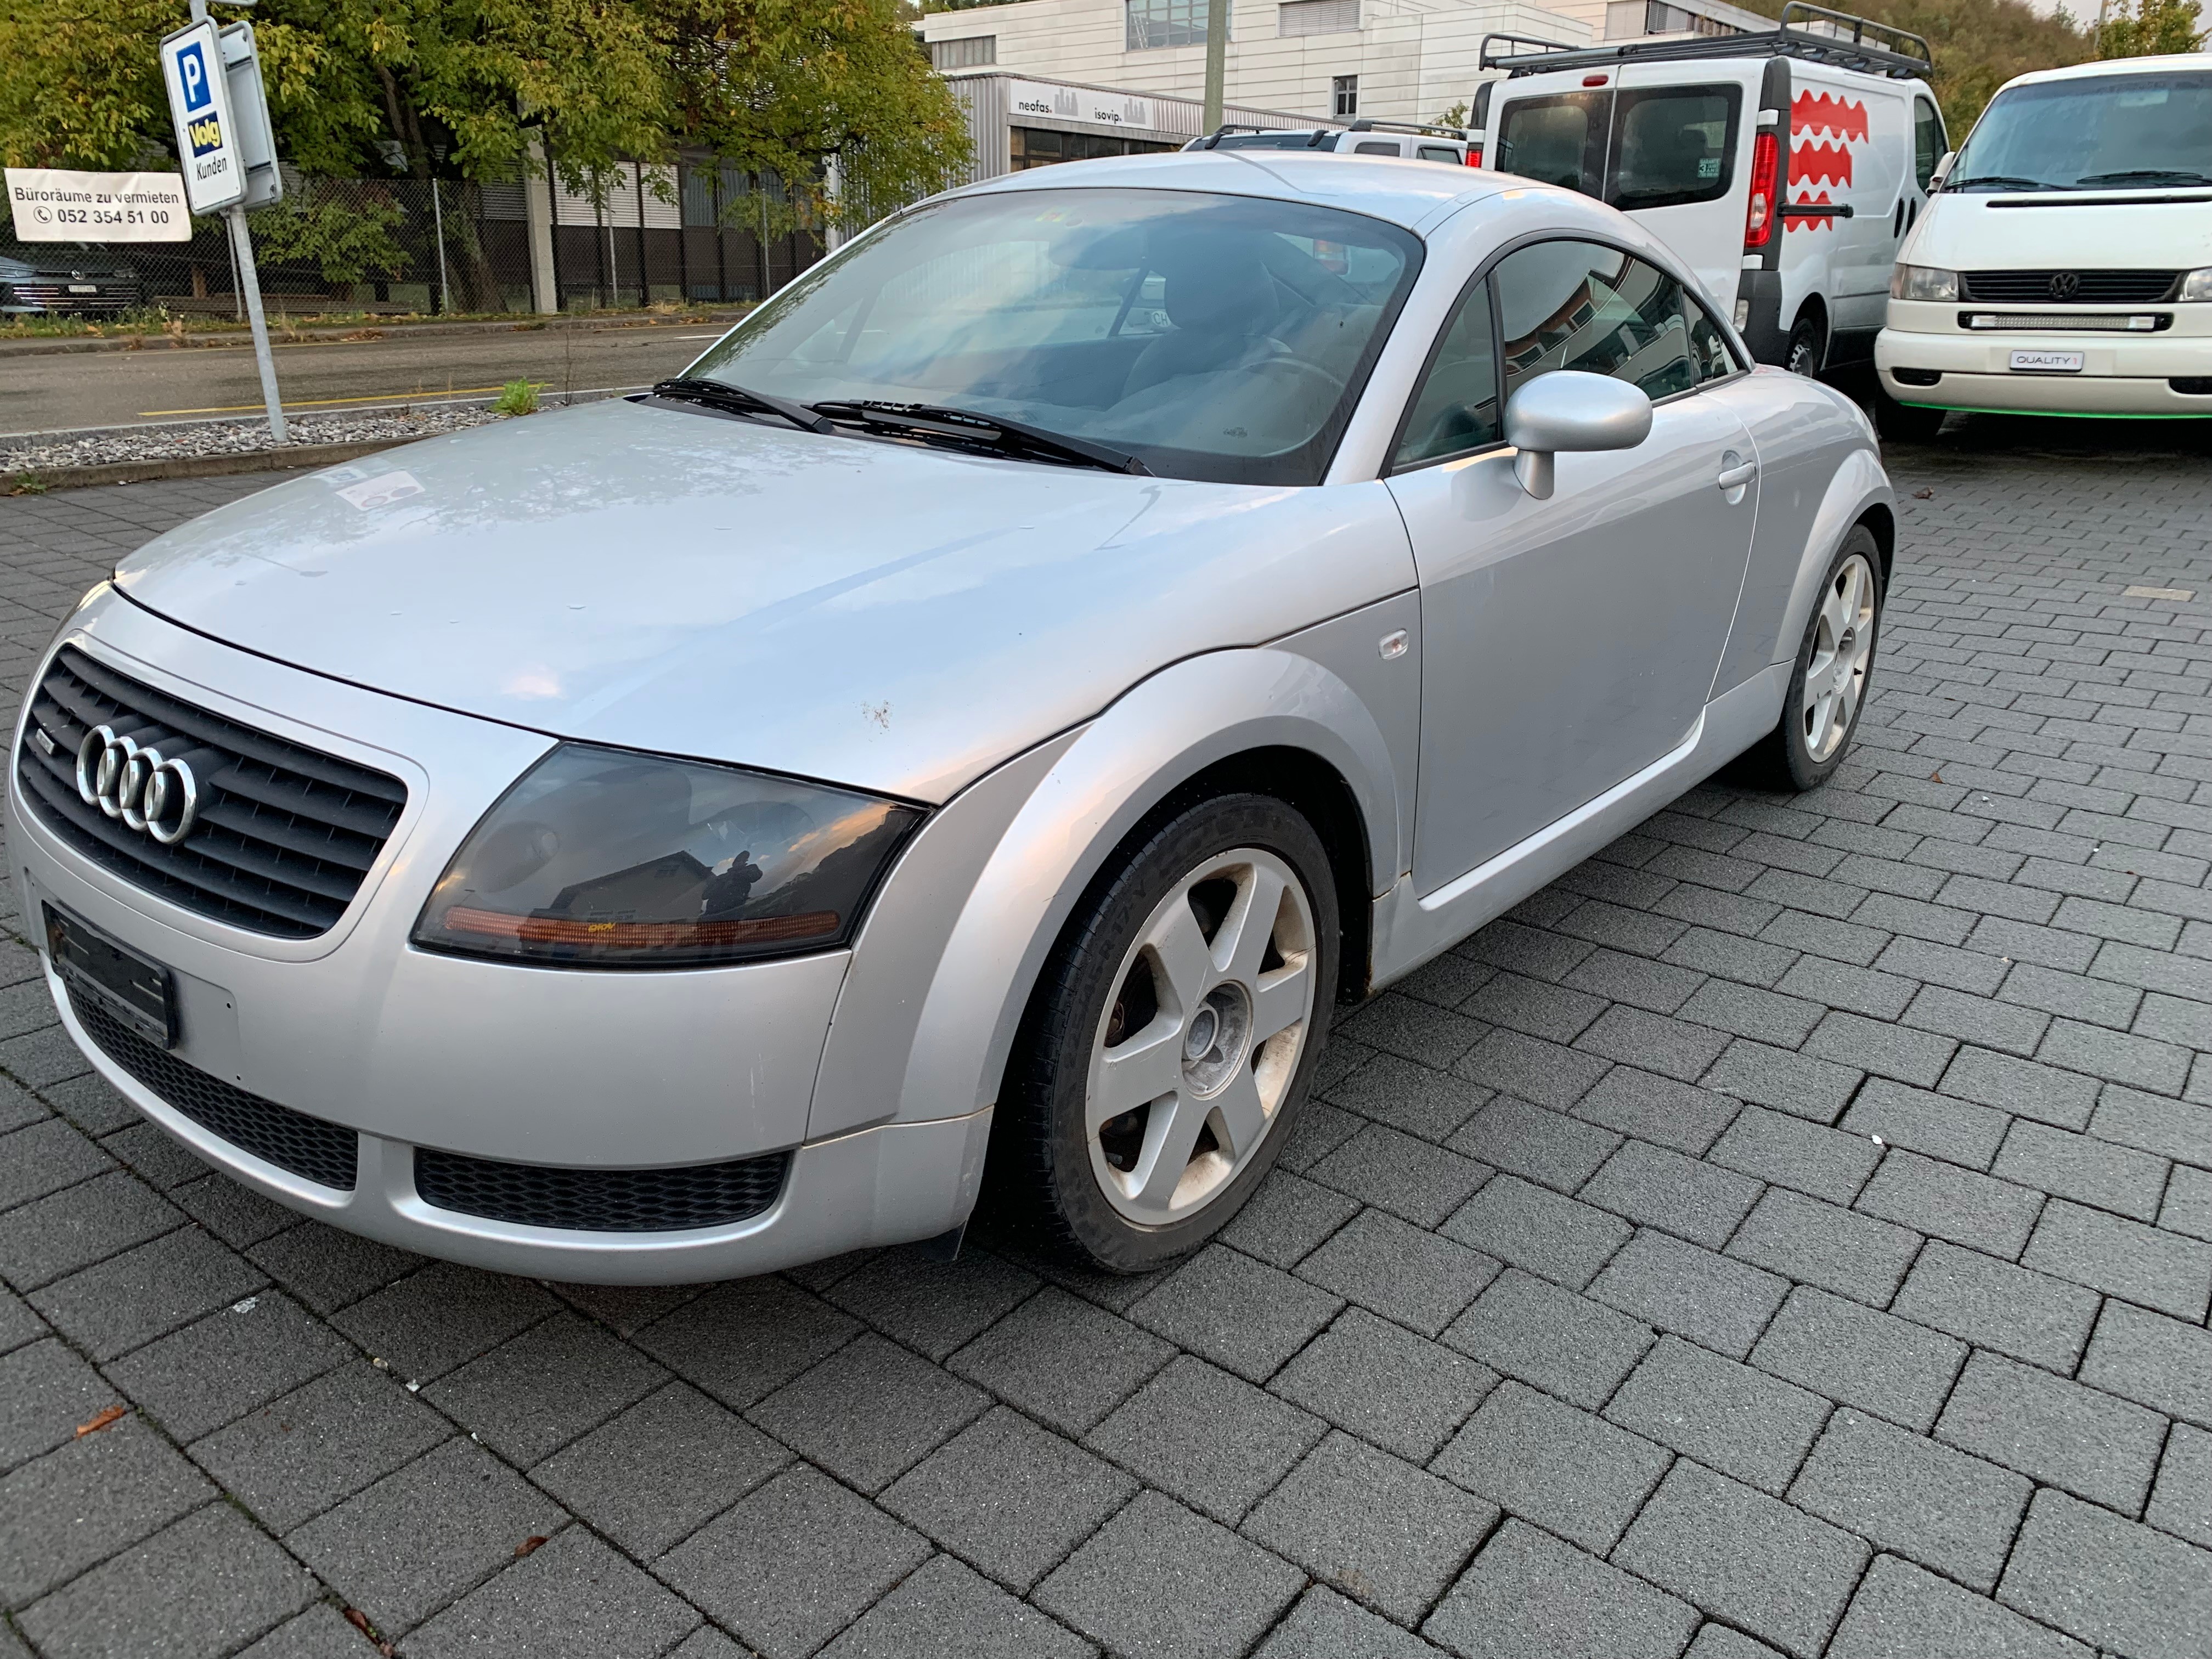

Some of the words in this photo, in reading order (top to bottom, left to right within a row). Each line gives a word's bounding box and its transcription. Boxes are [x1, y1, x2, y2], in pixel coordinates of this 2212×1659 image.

[182, 54, 201, 103] P
[189, 119, 220, 148] Volg
[196, 156, 228, 181] Kunden
[1699, 164, 1706, 173] 3
[14, 187, 92, 203] Büroräume
[97, 193, 111, 204] zu
[116, 190, 179, 204] vermieten
[58, 209, 87, 223] 052
[93, 210, 122, 224] 354
[128, 211, 144, 224] 51
[150, 211, 169, 224] 00
[1154, 312, 1169, 325] CH
[2017, 356, 2071, 364] QUALITY
